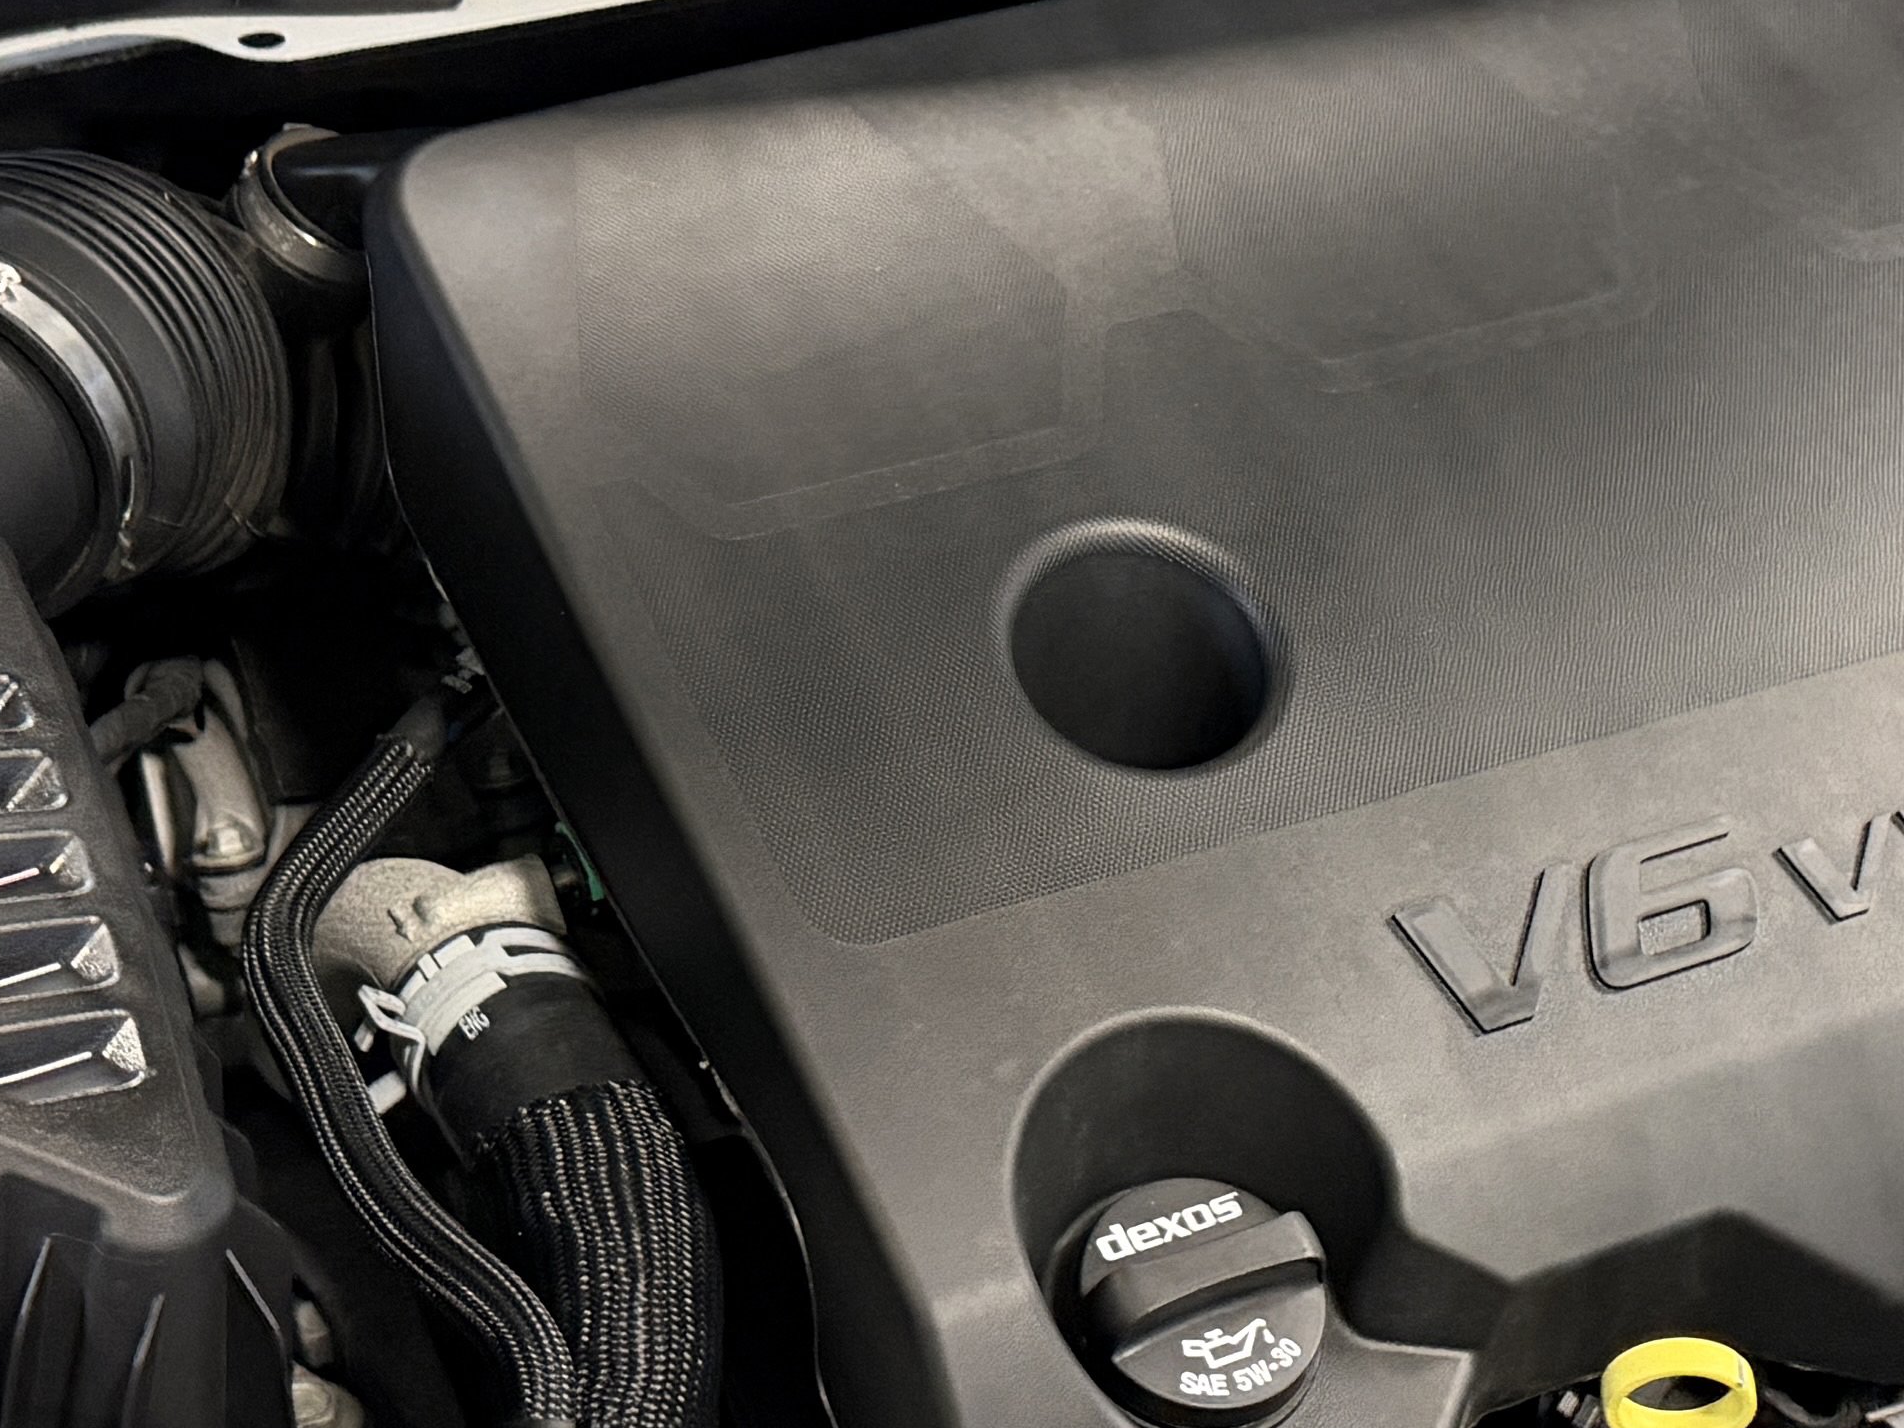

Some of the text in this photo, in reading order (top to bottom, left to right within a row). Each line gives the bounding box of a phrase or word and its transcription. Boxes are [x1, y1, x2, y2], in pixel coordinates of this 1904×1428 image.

[1389, 814, 1758, 1035] V6
[1096, 1191, 1243, 1262] dexos
[1179, 1337, 1302, 1396] SAE 5W-30
